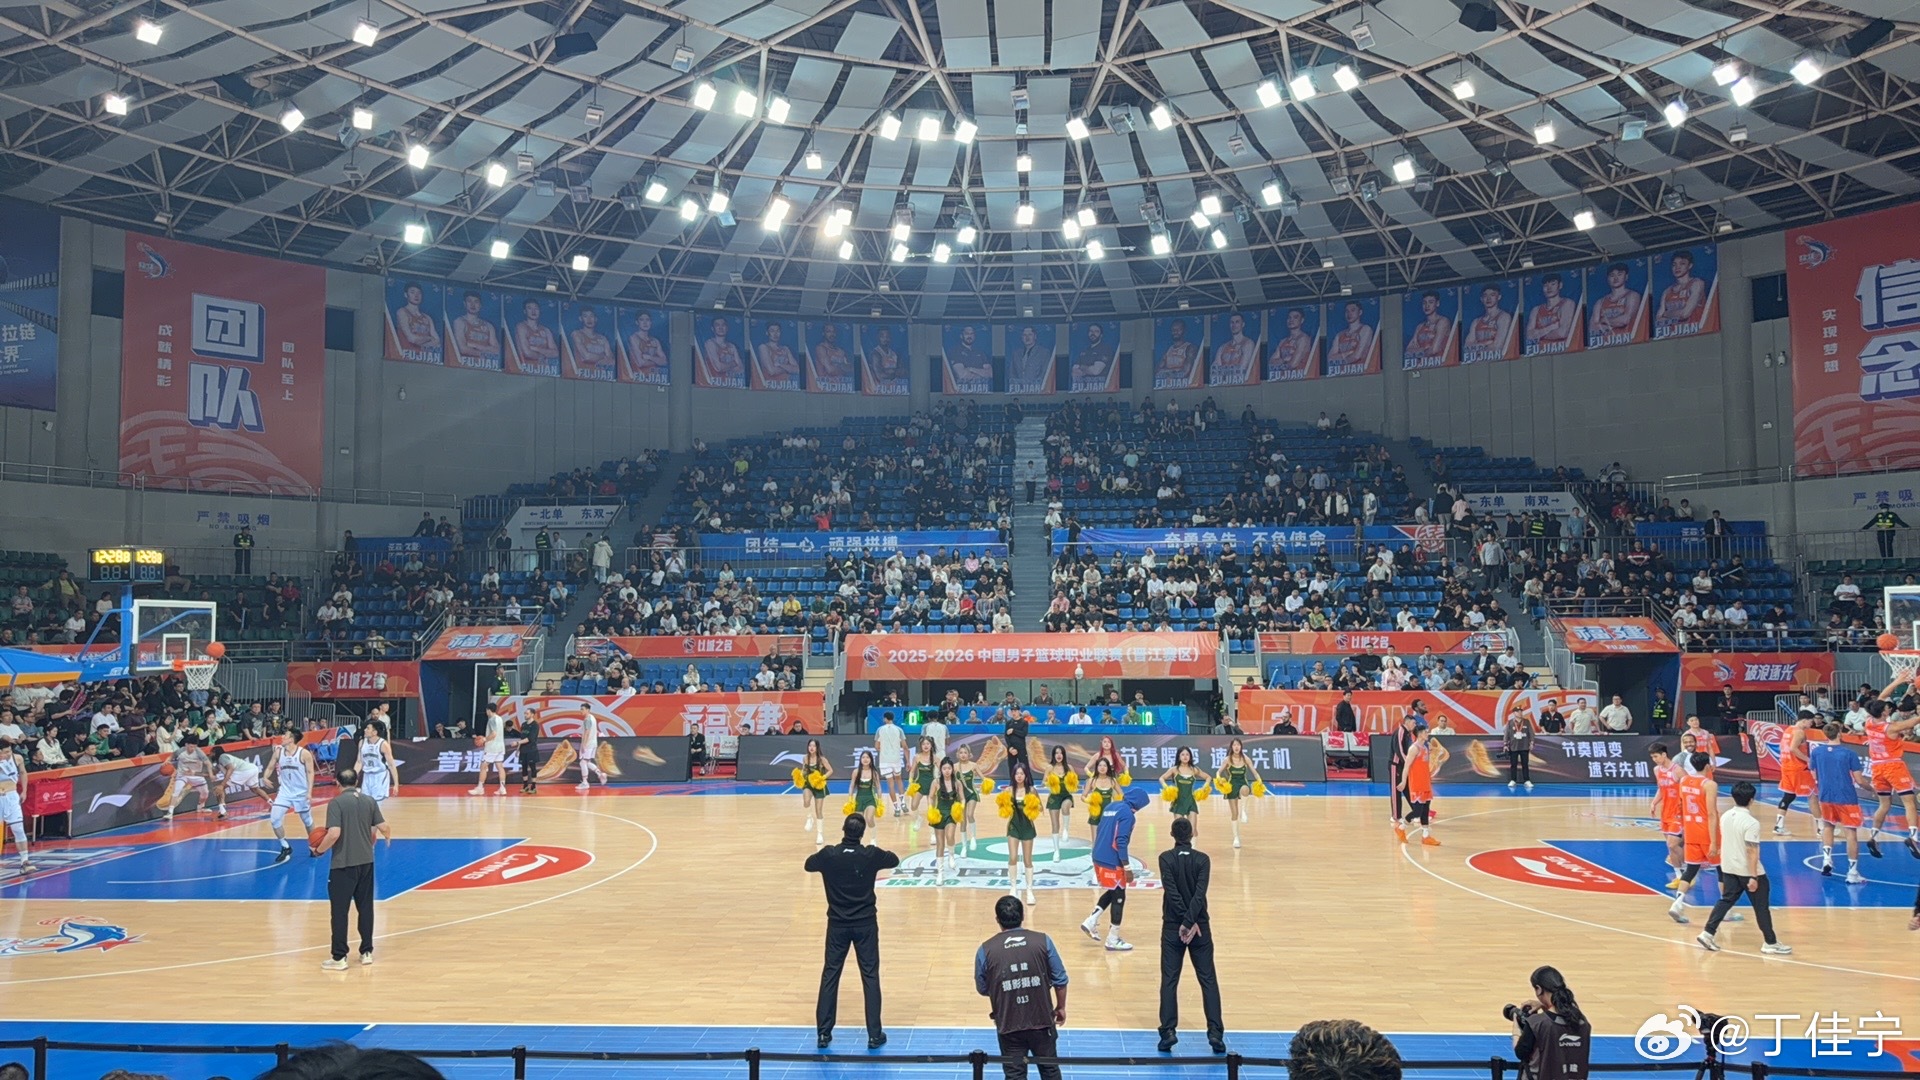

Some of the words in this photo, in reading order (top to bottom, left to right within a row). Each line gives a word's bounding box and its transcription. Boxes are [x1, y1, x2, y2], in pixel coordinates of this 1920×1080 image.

[1, 323, 36, 342] 拉链
[1655, 322, 1700, 338] FUJIAN
[1854, 258, 1920, 402] 信念
[1590, 332, 1631, 347] FUJIAN
[1822, 309, 1840, 372] 实现梦想
[0, 345, 20, 363] 界
[156, 324, 173, 387] 成就精彩
[1526, 342, 1566, 355] FUJIAN
[189, 293, 266, 433] 团队
[402, 350, 441, 362] FUJIAN
[461, 356, 499, 370] FUJIAN
[1404, 356, 1441, 368] FUJIAN
[1464, 350, 1500, 362] FUJIAN
[281, 341, 295, 401] 团队至上
[520, 363, 558, 376] FUJIAN
[578, 368, 614, 380] FUJIAN
[1270, 369, 1305, 380] FUJIAN
[1328, 364, 1364, 374] FUJIAN
[633, 372, 668, 384] FUJIAN
[710, 378, 744, 388] FUJIAN
[766, 380, 798, 390] FUJIAN
[1155, 378, 1189, 388] FUJIAN
[1211, 375, 1244, 385] FUJIAN
[1480, 495, 1506, 508] 东单
[1524, 495, 1550, 507] 南双
[197, 510, 270, 526] 严禁吸烟
[540, 508, 564, 520] 北单
[581, 508, 605, 519] 东双
[746, 537, 814, 554] 团结一心
[828, 536, 899, 552] 顽强拼搏
[1164, 531, 1236, 549] 奋勇争先
[1252, 530, 1326, 548] 不负使命
[1574, 625, 1653, 641] 福建
[448, 634, 520, 650] 福建
[698, 638, 733, 652] 以城之名
[1351, 635, 1390, 649] 以城之名
[888, 648, 974, 663] 2025-2026
[1744, 662, 1798, 681] 破浪逐光
[681, 701, 788, 736] 福建
[1562, 741, 1622, 758] 节奏瞬变
[1588, 761, 1650, 778] 速夺先机
[1004, 941, 1027, 949] LI-NING
[1010, 962, 1028, 972] 福建
[1002, 976, 1041, 992] 摄影摄像
[1016, 995, 1029, 1004] 013
